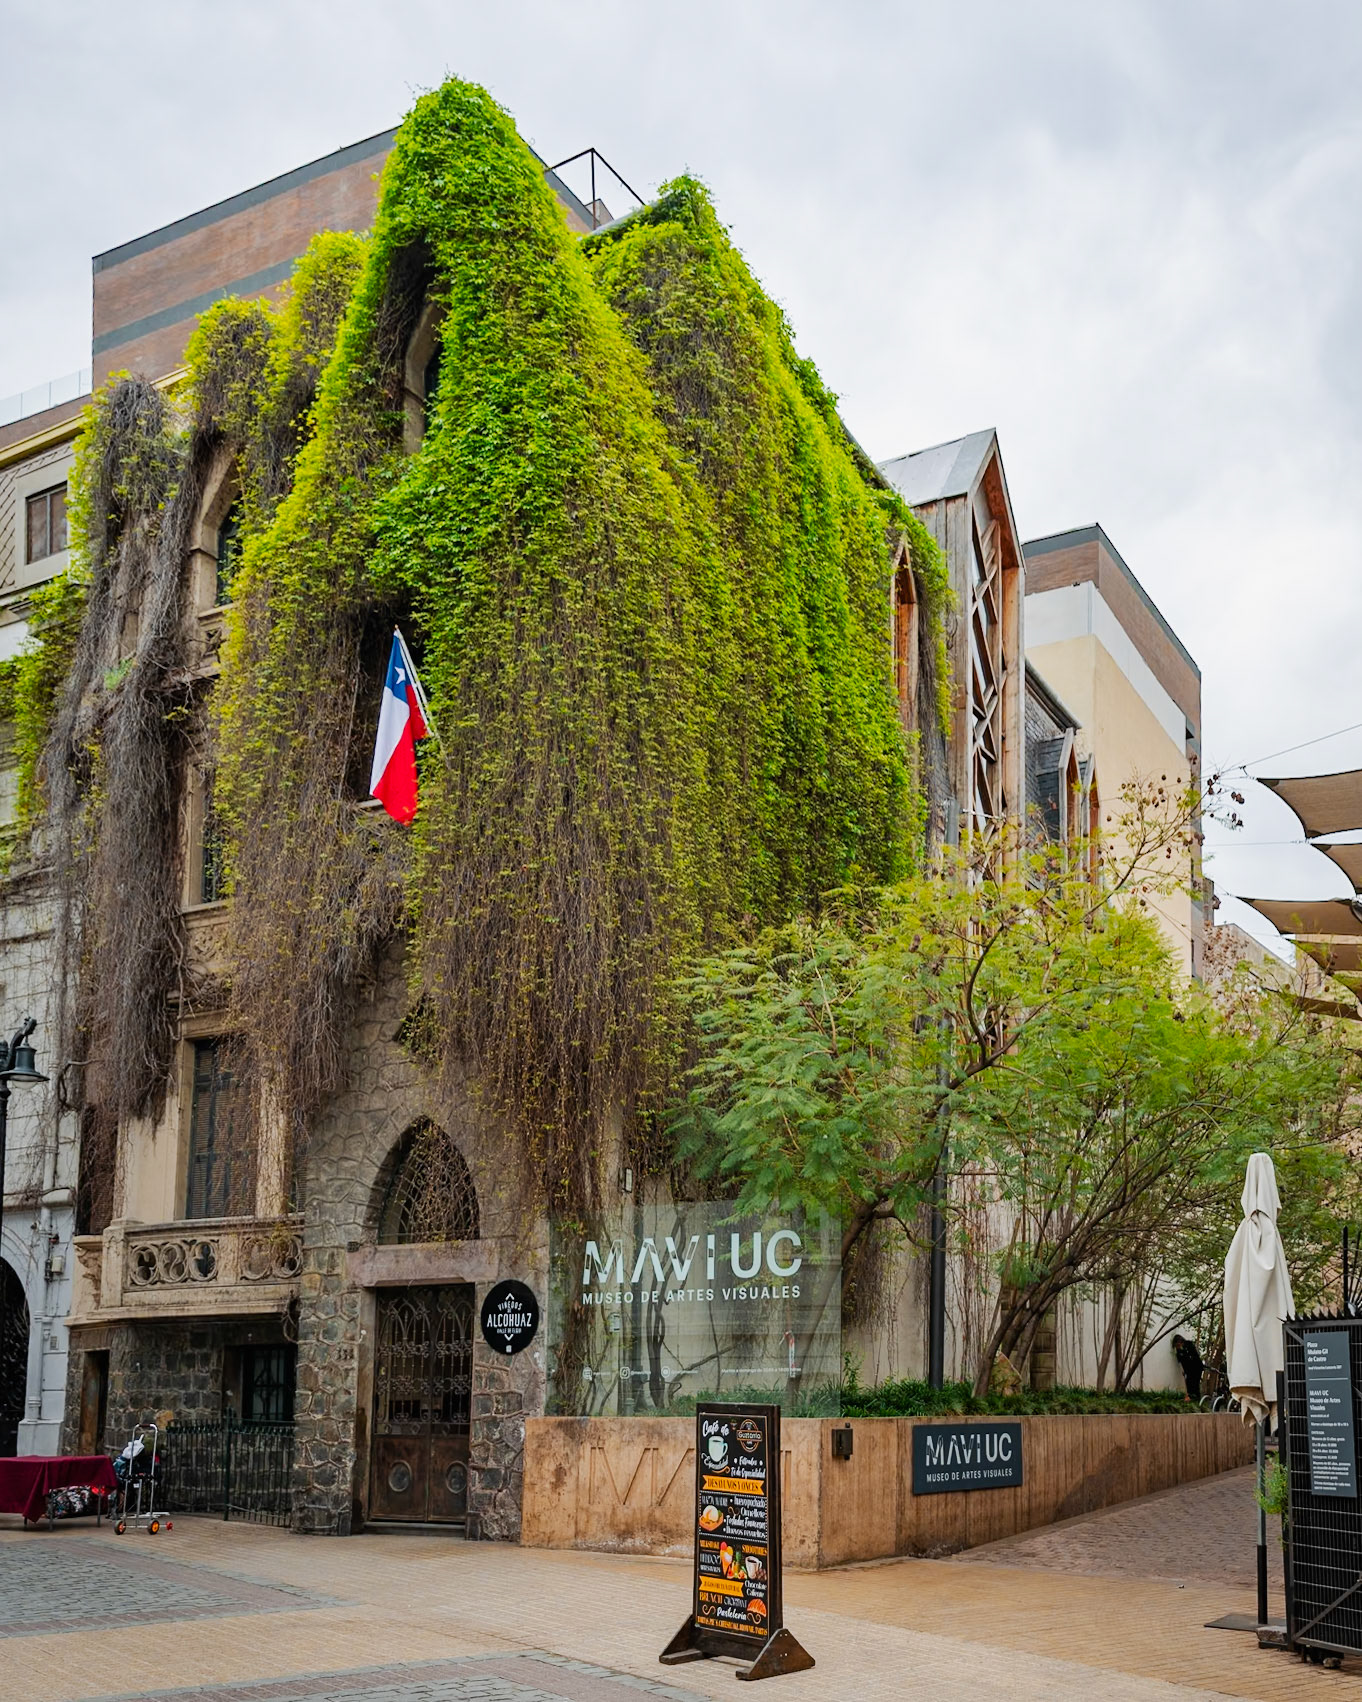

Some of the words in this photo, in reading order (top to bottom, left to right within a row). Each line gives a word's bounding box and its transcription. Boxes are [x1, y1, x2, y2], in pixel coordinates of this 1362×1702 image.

[582, 1234, 715, 1285] MAVI
[731, 1230, 802, 1279] UC
[582, 1292, 634, 1305] MUSEO
[641, 1291, 658, 1303] DE
[666, 1288, 715, 1302] ARTES
[722, 1285, 801, 1300] VISUALES
[486, 1313, 532, 1328] ALCOHUAZ
[703, 1420, 719, 1437] Café
[721, 1424, 729, 1436] de
[926, 1433, 981, 1466] MAVI
[985, 1433, 1012, 1462] UC
[926, 1473, 950, 1482] MUSEO
[951, 1471, 960, 1480] DE
[961, 1470, 981, 1479] ARTES
[983, 1468, 1013, 1478] VISUALES
[708, 1478, 737, 1490] DESAYUNOS
